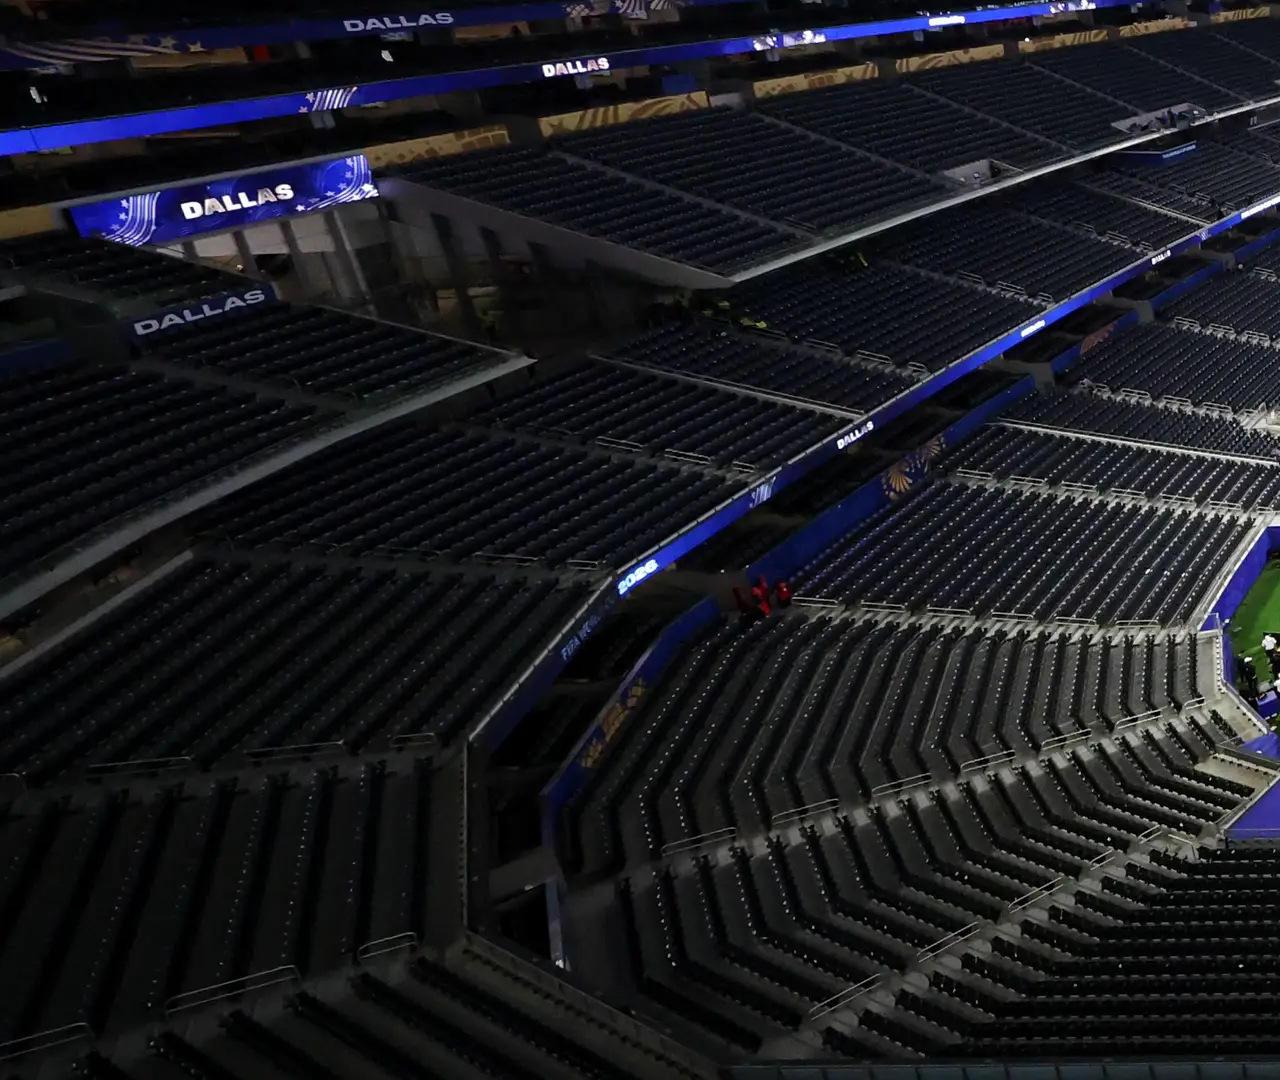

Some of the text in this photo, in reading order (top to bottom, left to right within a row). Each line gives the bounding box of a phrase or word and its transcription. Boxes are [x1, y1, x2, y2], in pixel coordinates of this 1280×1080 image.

[343, 13, 454, 32] DALLAS
[542, 58, 610, 78] DALLAS
[181, 184, 295, 220] DALLAS
[134, 290, 265, 336] DALLAS
[837, 421, 874, 449] DALLAS
[618, 559, 659, 595] 2026
